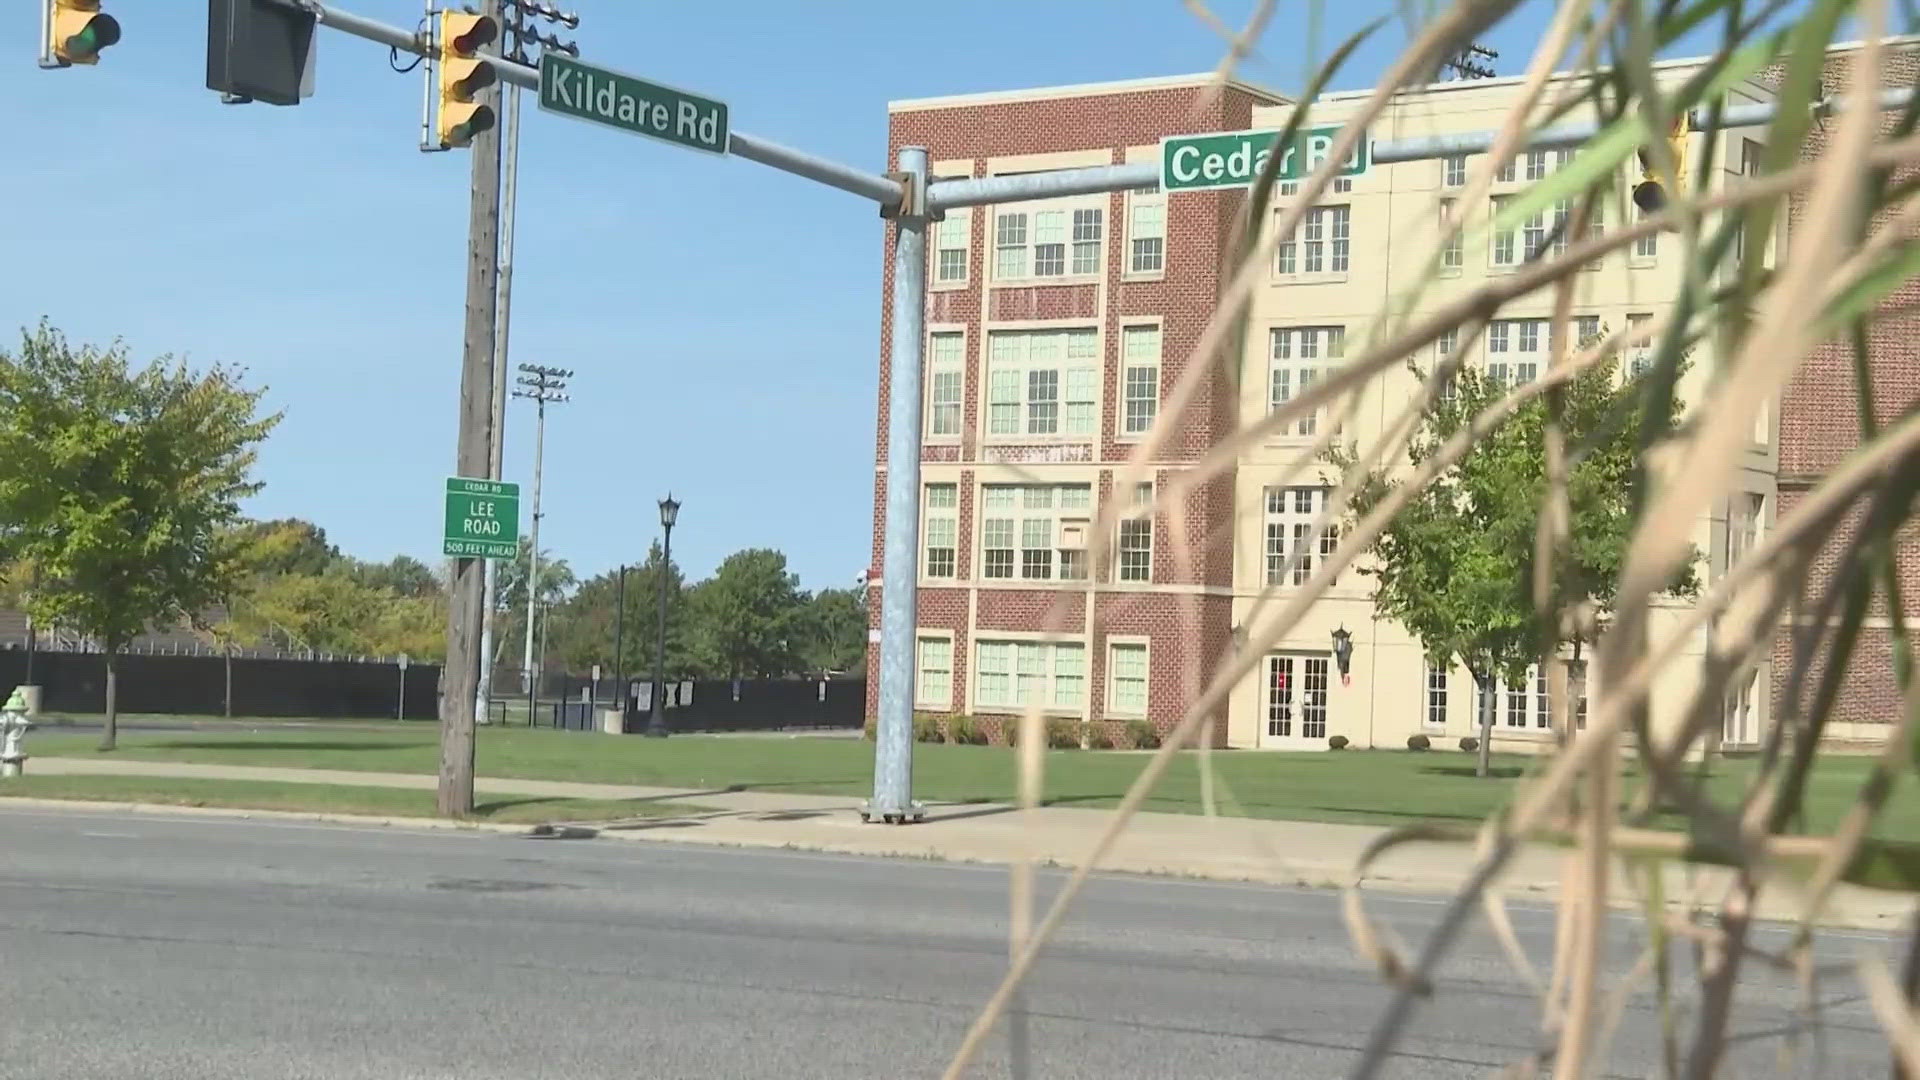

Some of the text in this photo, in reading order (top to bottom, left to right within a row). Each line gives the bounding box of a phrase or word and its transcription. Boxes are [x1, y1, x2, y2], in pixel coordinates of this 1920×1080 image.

[551, 64, 718, 145] Kildare Rd
[1172, 141, 1296, 182] Cedar
[464, 481, 502, 493] CEDAR RD
[470, 501, 495, 518] LEE
[463, 518, 501, 535] ROAD
[446, 541, 515, 556] 500 FEET AHEAD
